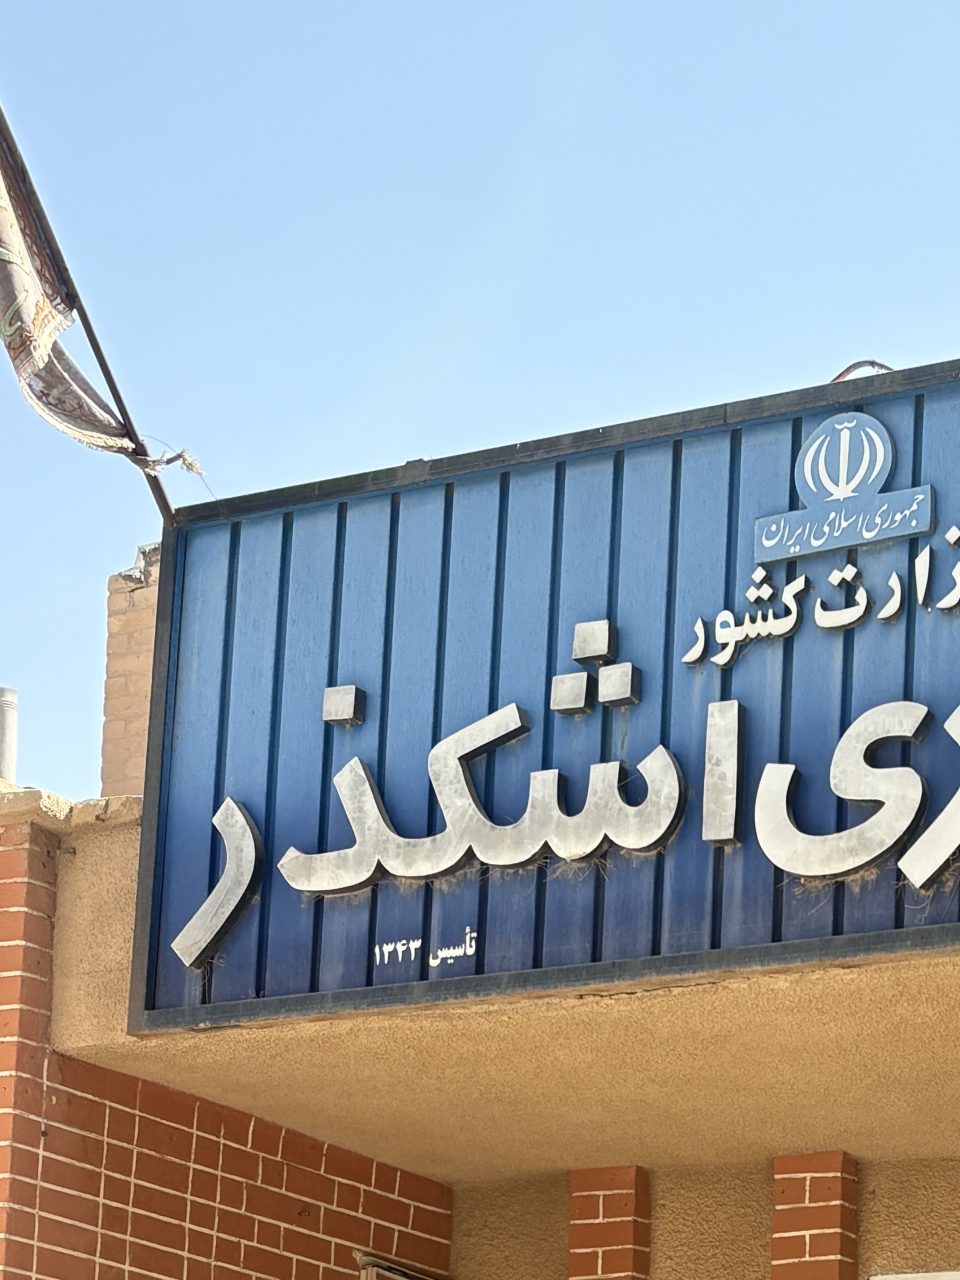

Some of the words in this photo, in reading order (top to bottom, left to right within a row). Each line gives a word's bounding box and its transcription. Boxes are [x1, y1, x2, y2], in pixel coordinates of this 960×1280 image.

[761, 516, 810, 553] ایران
[810, 508, 864, 547] اسلامی
[862, 494, 925, 539] جمهوری
[680, 566, 808, 666] کشور
[170, 619, 743, 967] اشکذر
[374, 938, 422, 966] ۱۳۴۳
